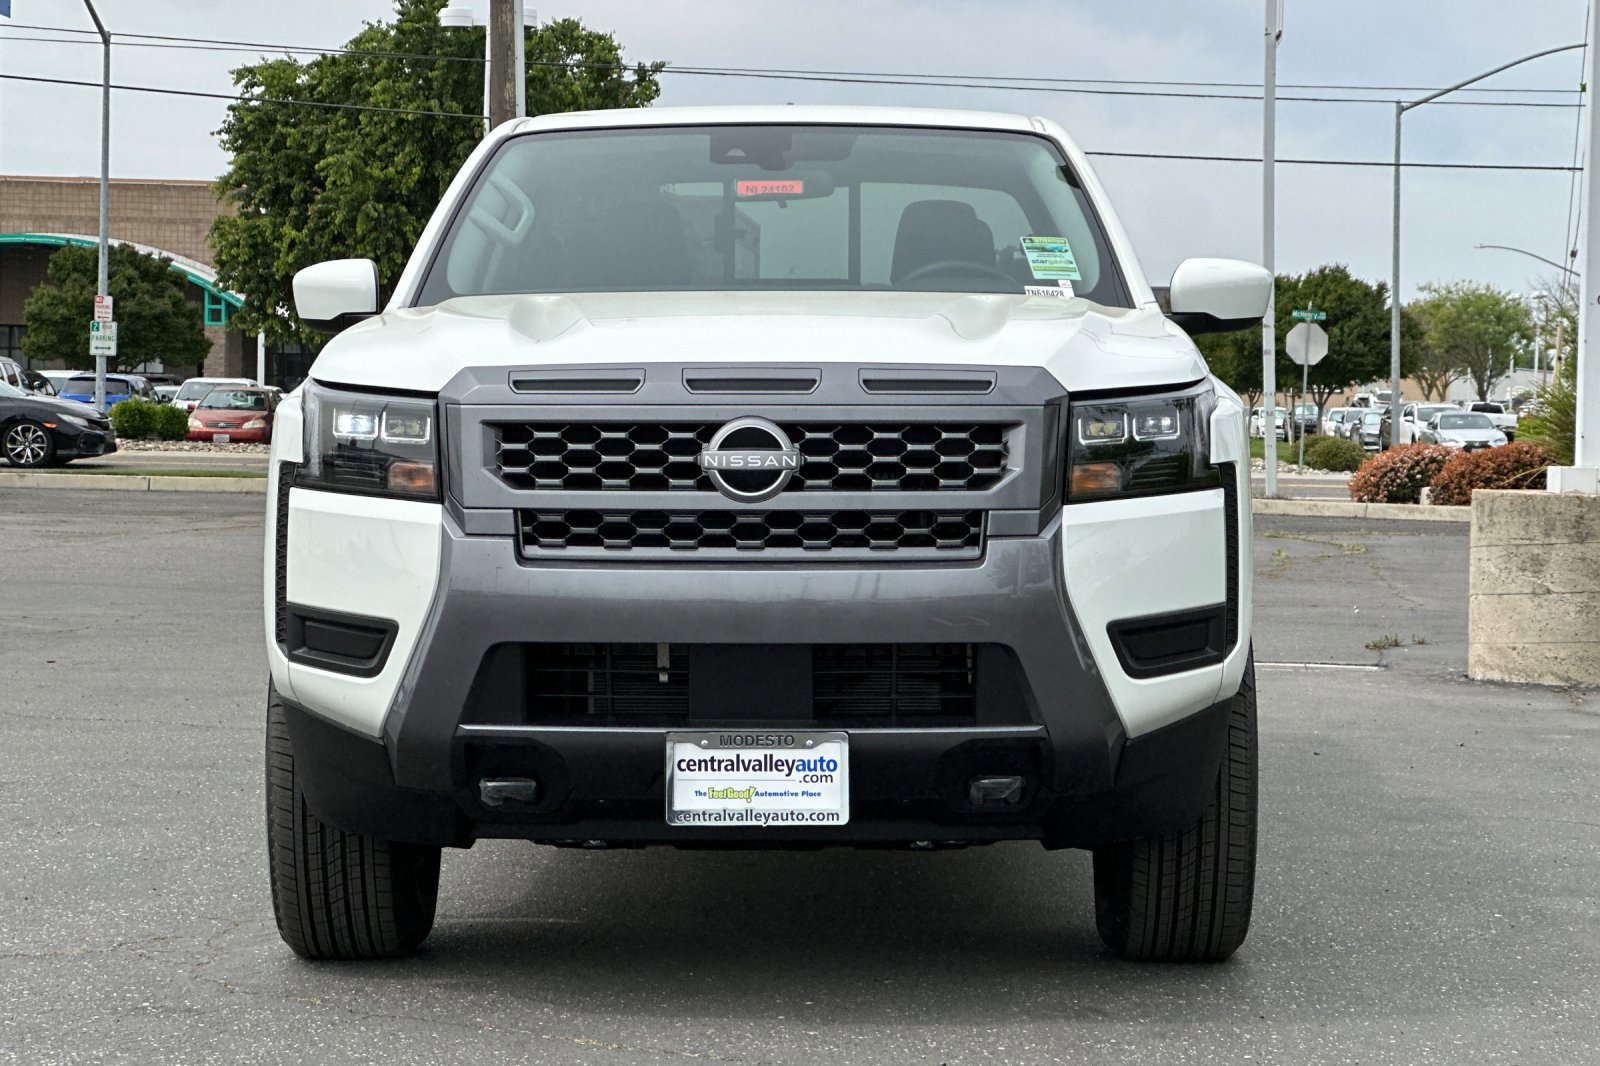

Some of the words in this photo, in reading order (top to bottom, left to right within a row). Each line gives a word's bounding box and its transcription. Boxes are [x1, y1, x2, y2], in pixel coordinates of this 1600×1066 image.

[1292, 310, 1318, 319] McHenry
[93, 322, 99, 331] 2
[91, 334, 115, 342] PARKING
[704, 455, 796, 467] NISSAN
[719, 734, 795, 747] MODESTO
[677, 754, 838, 777] centralvalleyauto
[799, 773, 834, 783] .com
[754, 789, 798, 797] Automotive
[801, 789, 821, 797] Place
[676, 809, 840, 824] centralvalleyauto.com
